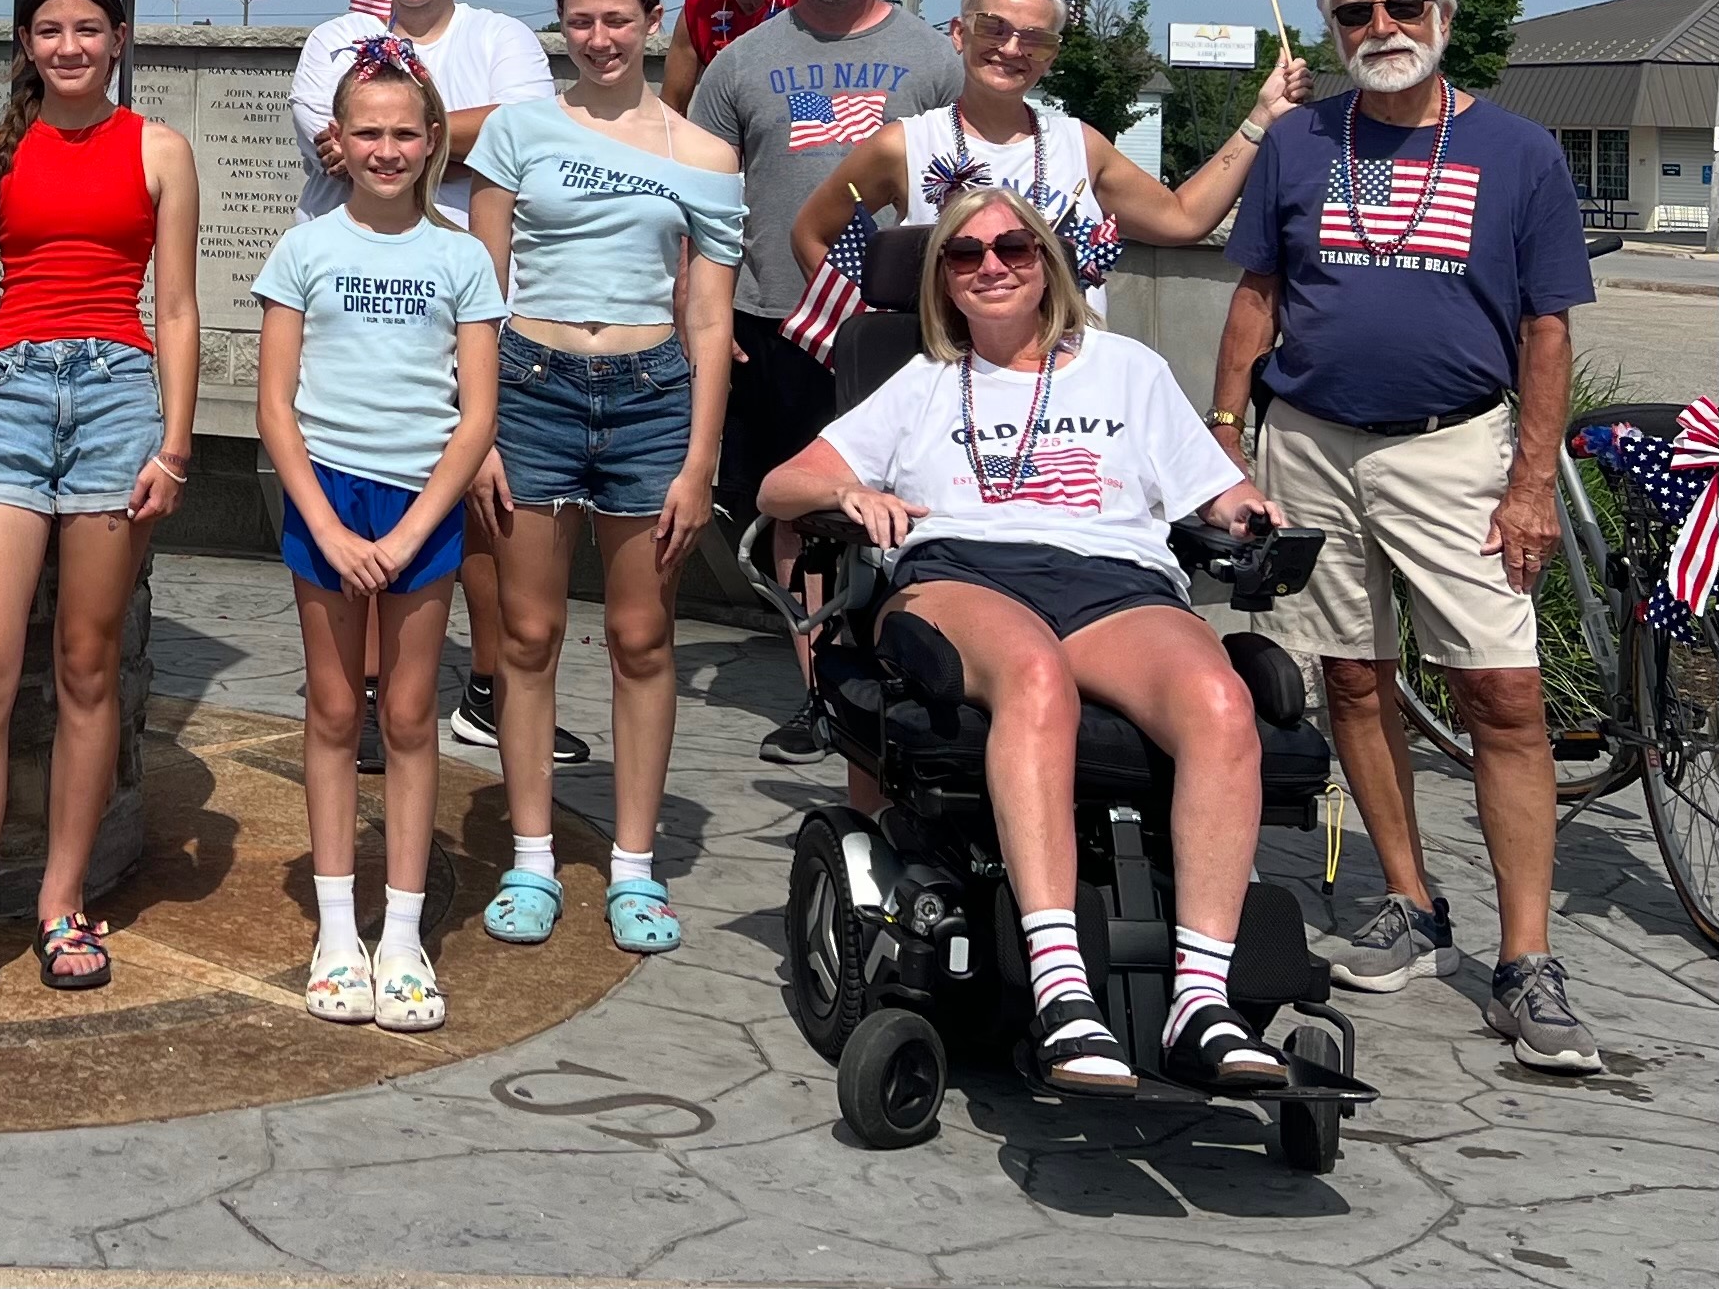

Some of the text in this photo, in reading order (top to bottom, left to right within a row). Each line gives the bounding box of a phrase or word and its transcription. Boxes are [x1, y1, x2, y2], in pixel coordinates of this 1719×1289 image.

[207, 66, 227, 75] RAY
[229, 67, 238, 76] &
[240, 68, 272, 77] SUSAN
[769, 62, 910, 94] OLD NAVY
[139, 96, 163, 105] CITY
[210, 100, 253, 110] ZEALAN
[255, 101, 263, 111] &
[243, 113, 281, 123] ABBITT
[204, 133, 228, 143] TOM
[230, 134, 239, 144] &
[241, 135, 273, 145] MARY
[217, 157, 303, 170] CARMEUSE LIME
[230, 169, 290, 181] AND STONE
[562, 174, 653, 194] DIRECT
[221, 191, 299, 203] IN MEMORY OF
[222, 203, 249, 213] JACK
[262, 205, 297, 215] PERRY
[1319, 250, 1467, 276] THANKS TO THE BRAVE
[335, 276, 436, 299] FIREWORKS
[343, 294, 427, 316] DIRECTOR
[951, 416, 1125, 446] OLD NAVY
[952, 477, 977, 486] EST.
